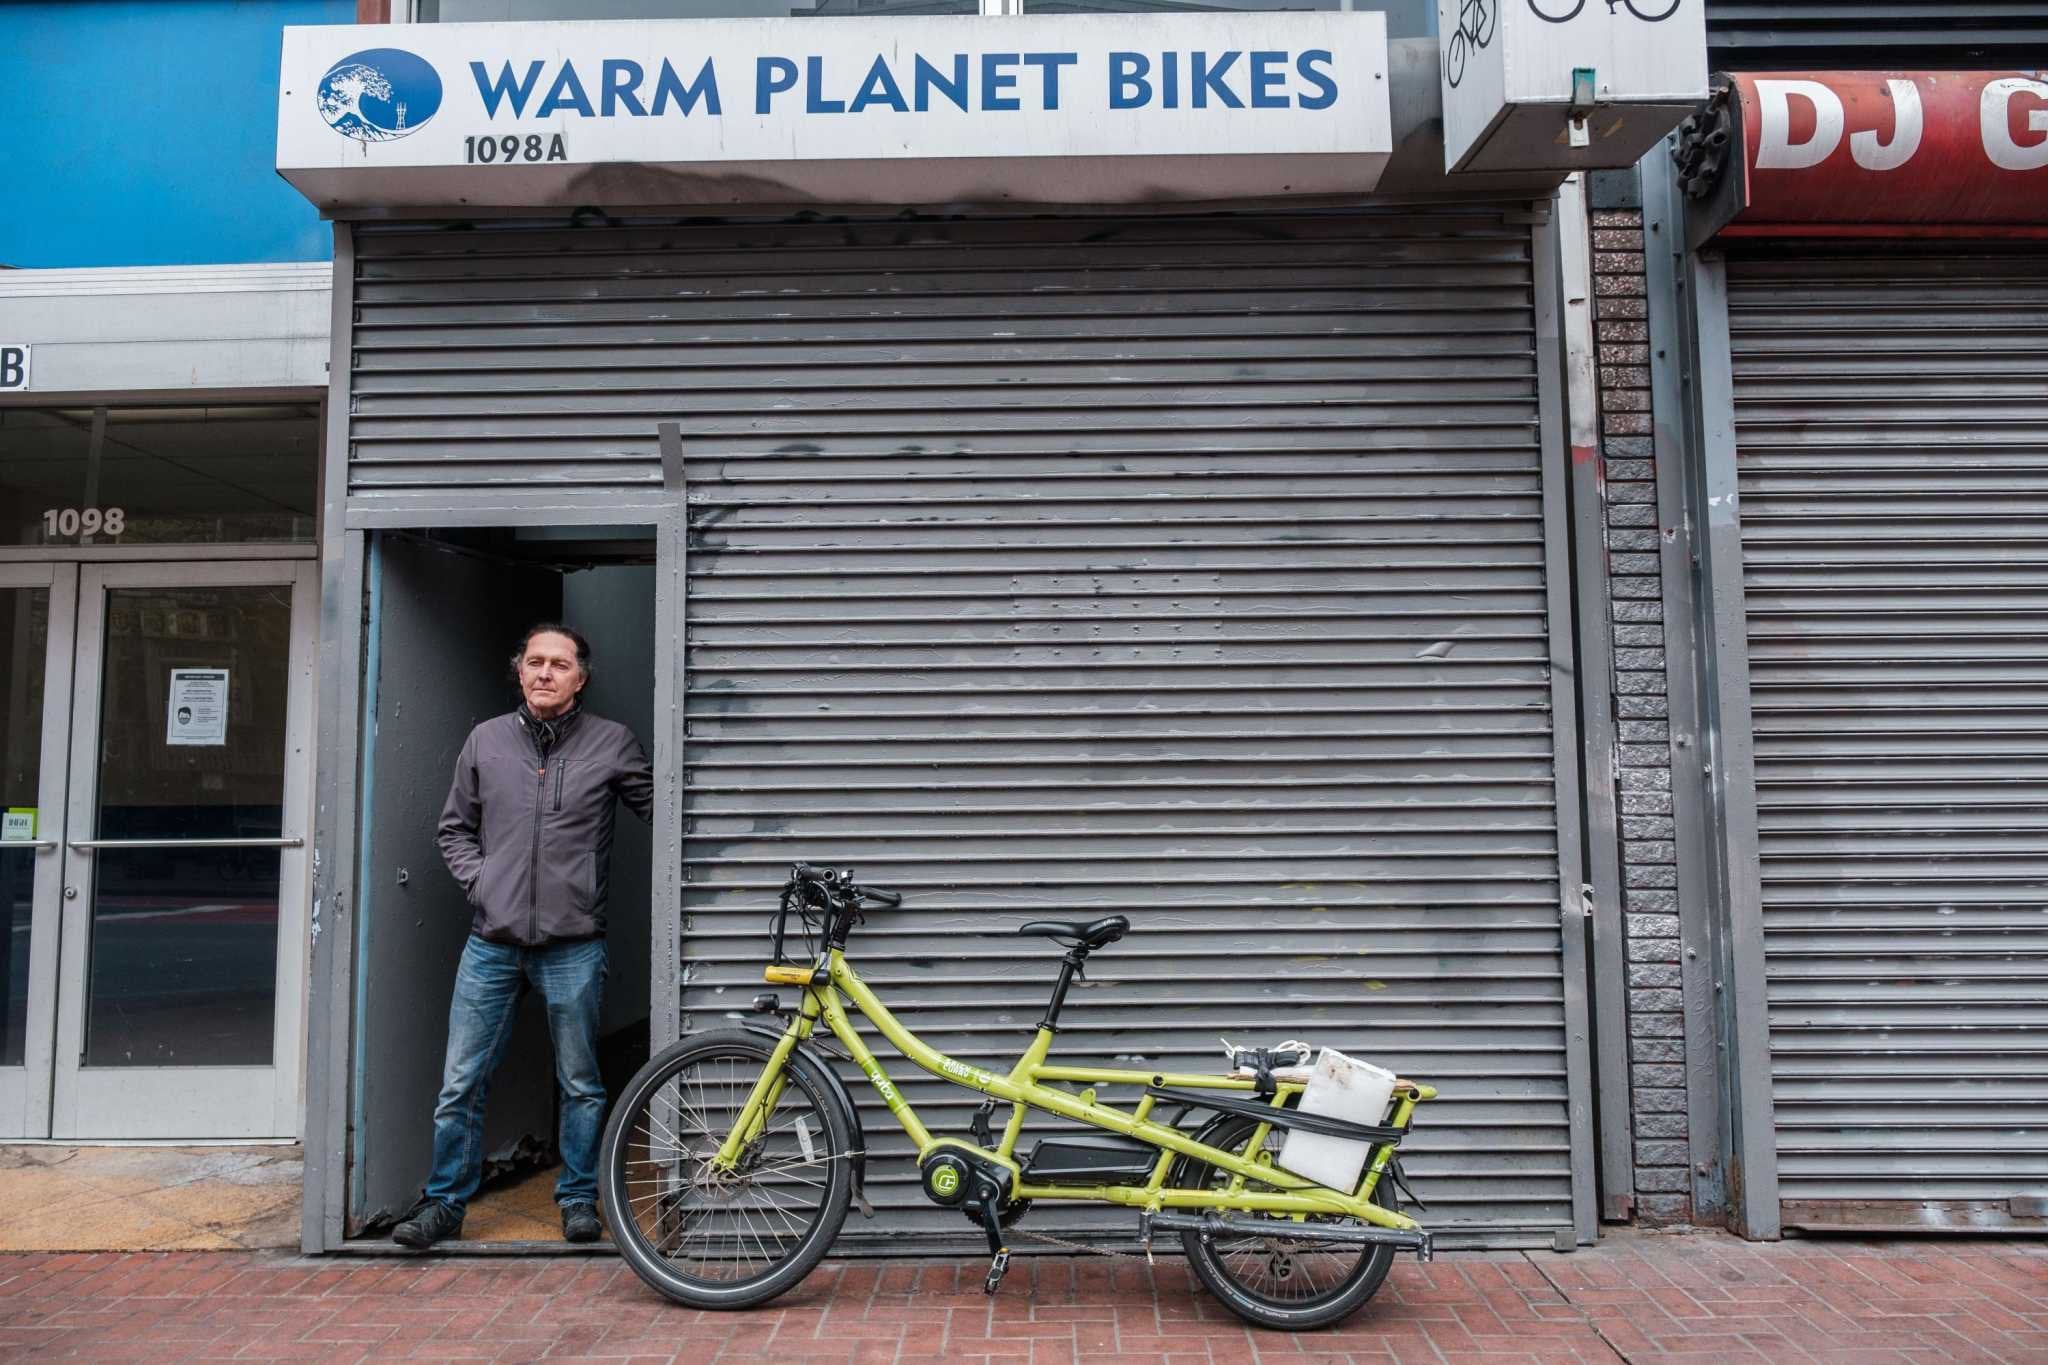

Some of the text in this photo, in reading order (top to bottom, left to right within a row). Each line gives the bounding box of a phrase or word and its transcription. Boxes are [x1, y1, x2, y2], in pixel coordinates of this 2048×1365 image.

[470, 49, 1338, 121] WARM PLANET BIKES
[1753, 79, 1923, 170] DJ
[464, 135, 567, 164] 1098A
[0, 347, 24, 388] B
[43, 508, 125, 536] 1098
